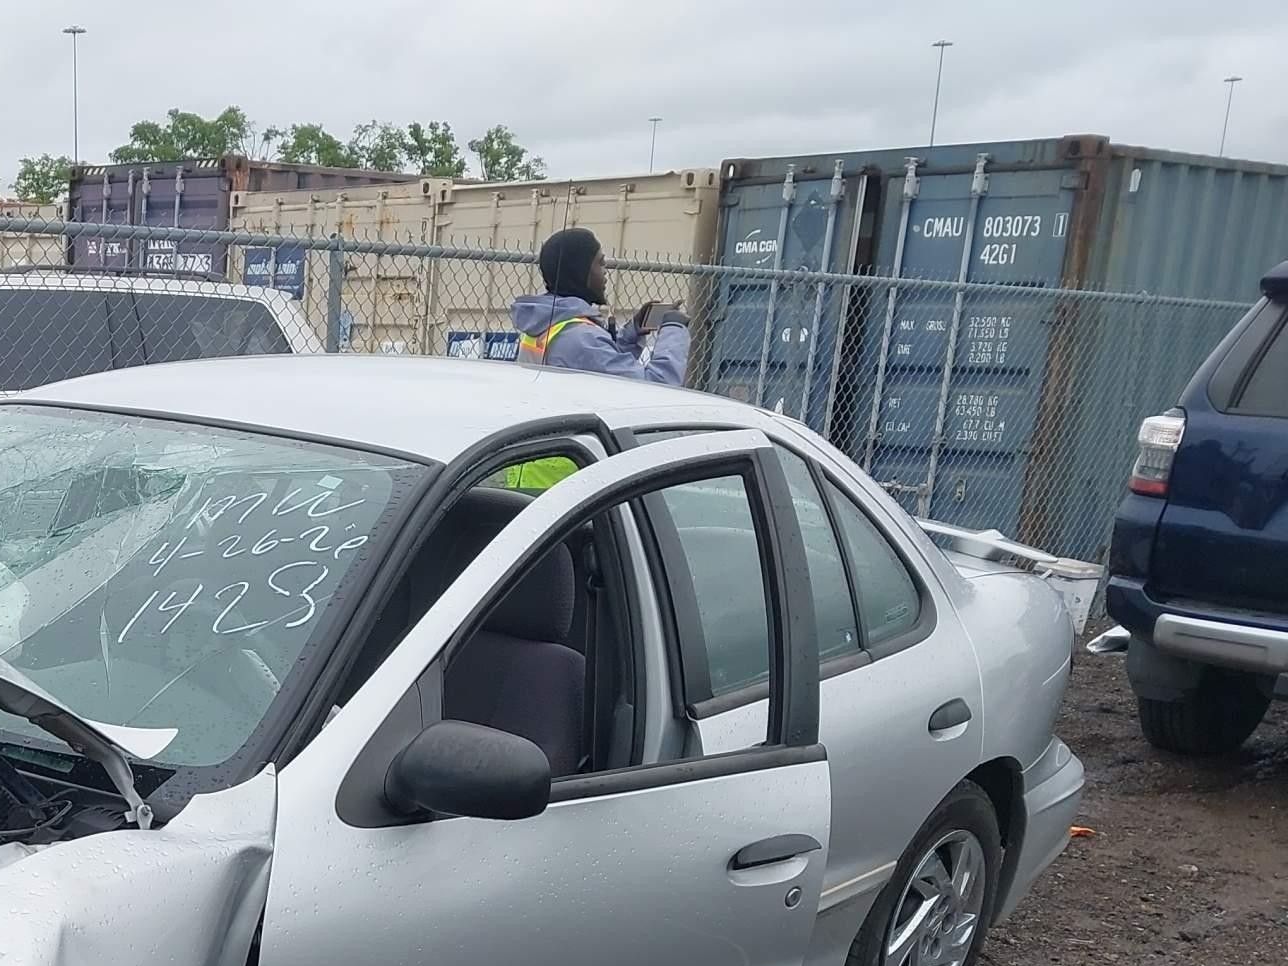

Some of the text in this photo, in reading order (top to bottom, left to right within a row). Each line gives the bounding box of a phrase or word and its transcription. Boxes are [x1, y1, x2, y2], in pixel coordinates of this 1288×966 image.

[923, 217, 964, 238] CMAU
[983, 215, 1041, 237] 803073
[735, 241, 758, 254] CMA
[980, 243, 1017, 265] 42G1
